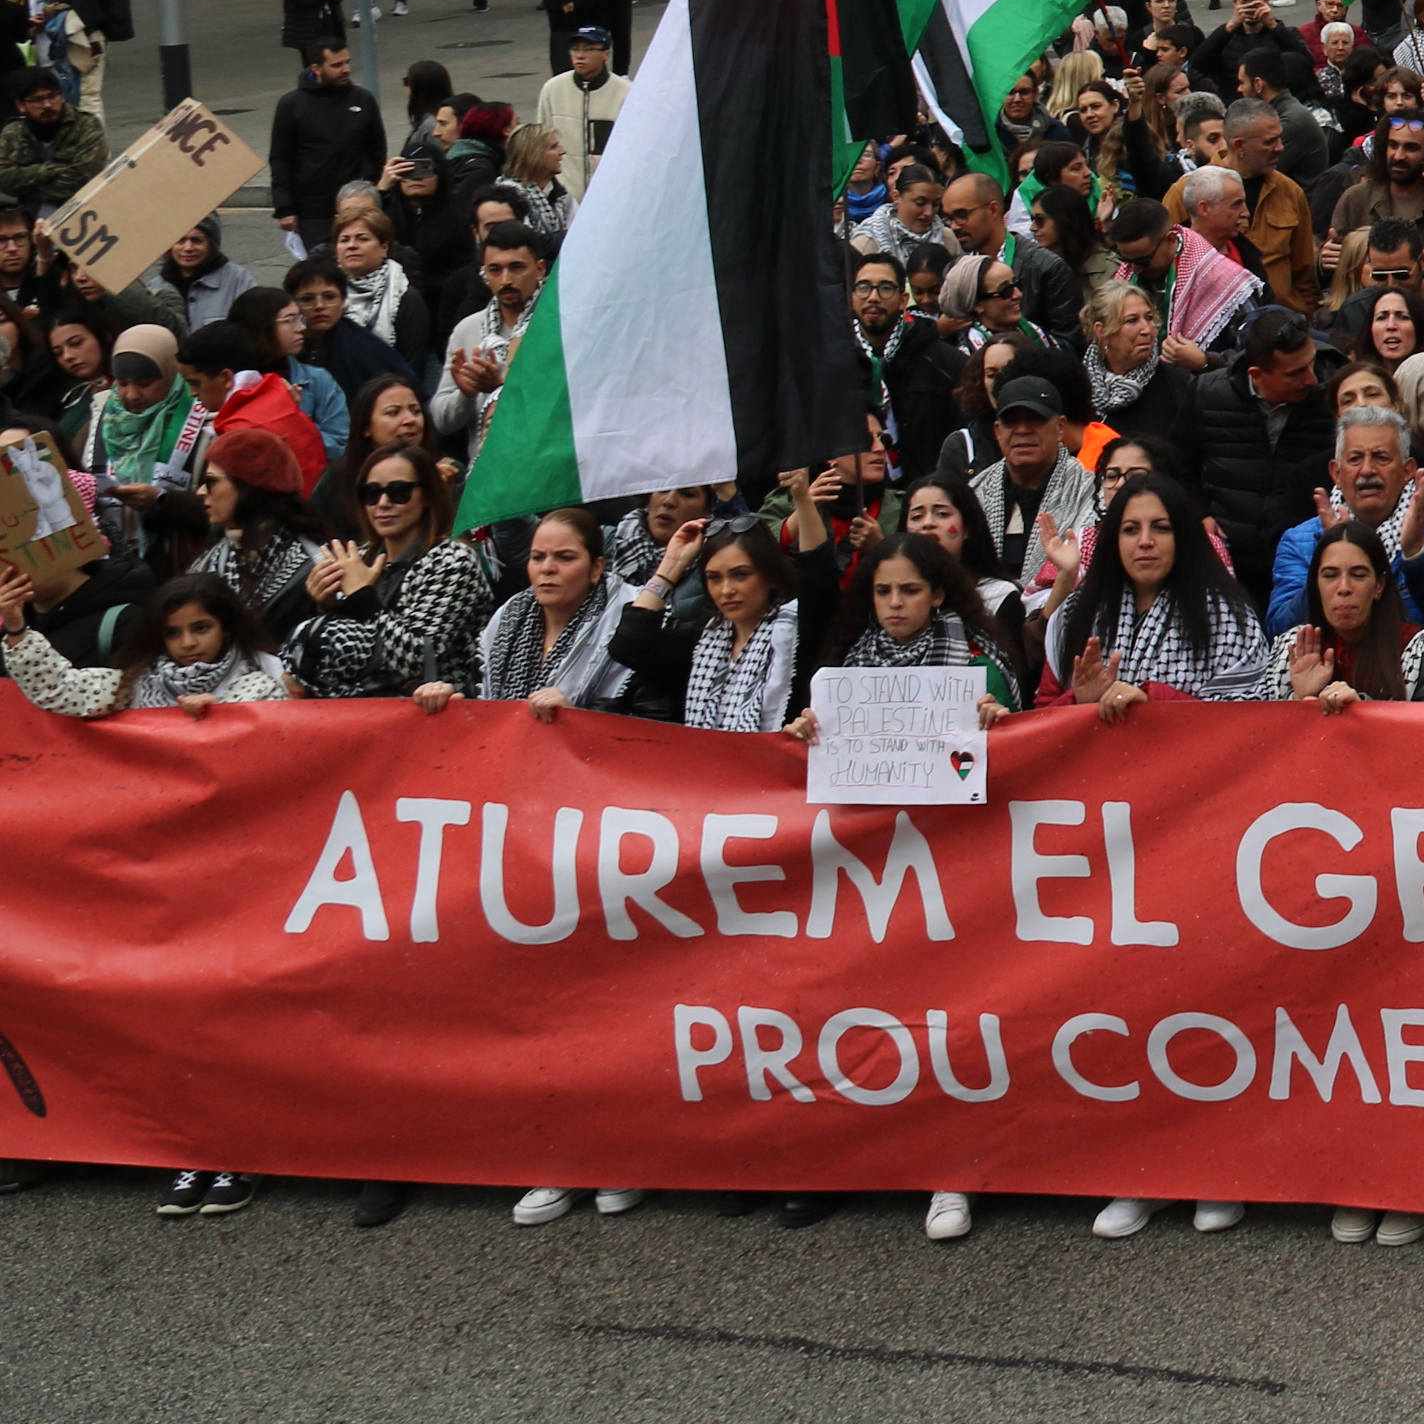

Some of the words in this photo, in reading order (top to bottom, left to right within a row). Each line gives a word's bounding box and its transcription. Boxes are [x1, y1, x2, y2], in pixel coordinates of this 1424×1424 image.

[823, 677, 853, 704] TO
[860, 676, 922, 703] STAND
[847, 738, 864, 753] TO
[870, 737, 909, 753] STAND
[284, 790, 956, 950] ATUREM
[1009, 799, 1180, 947] EL
[673, 1003, 1010, 1106] PROU
